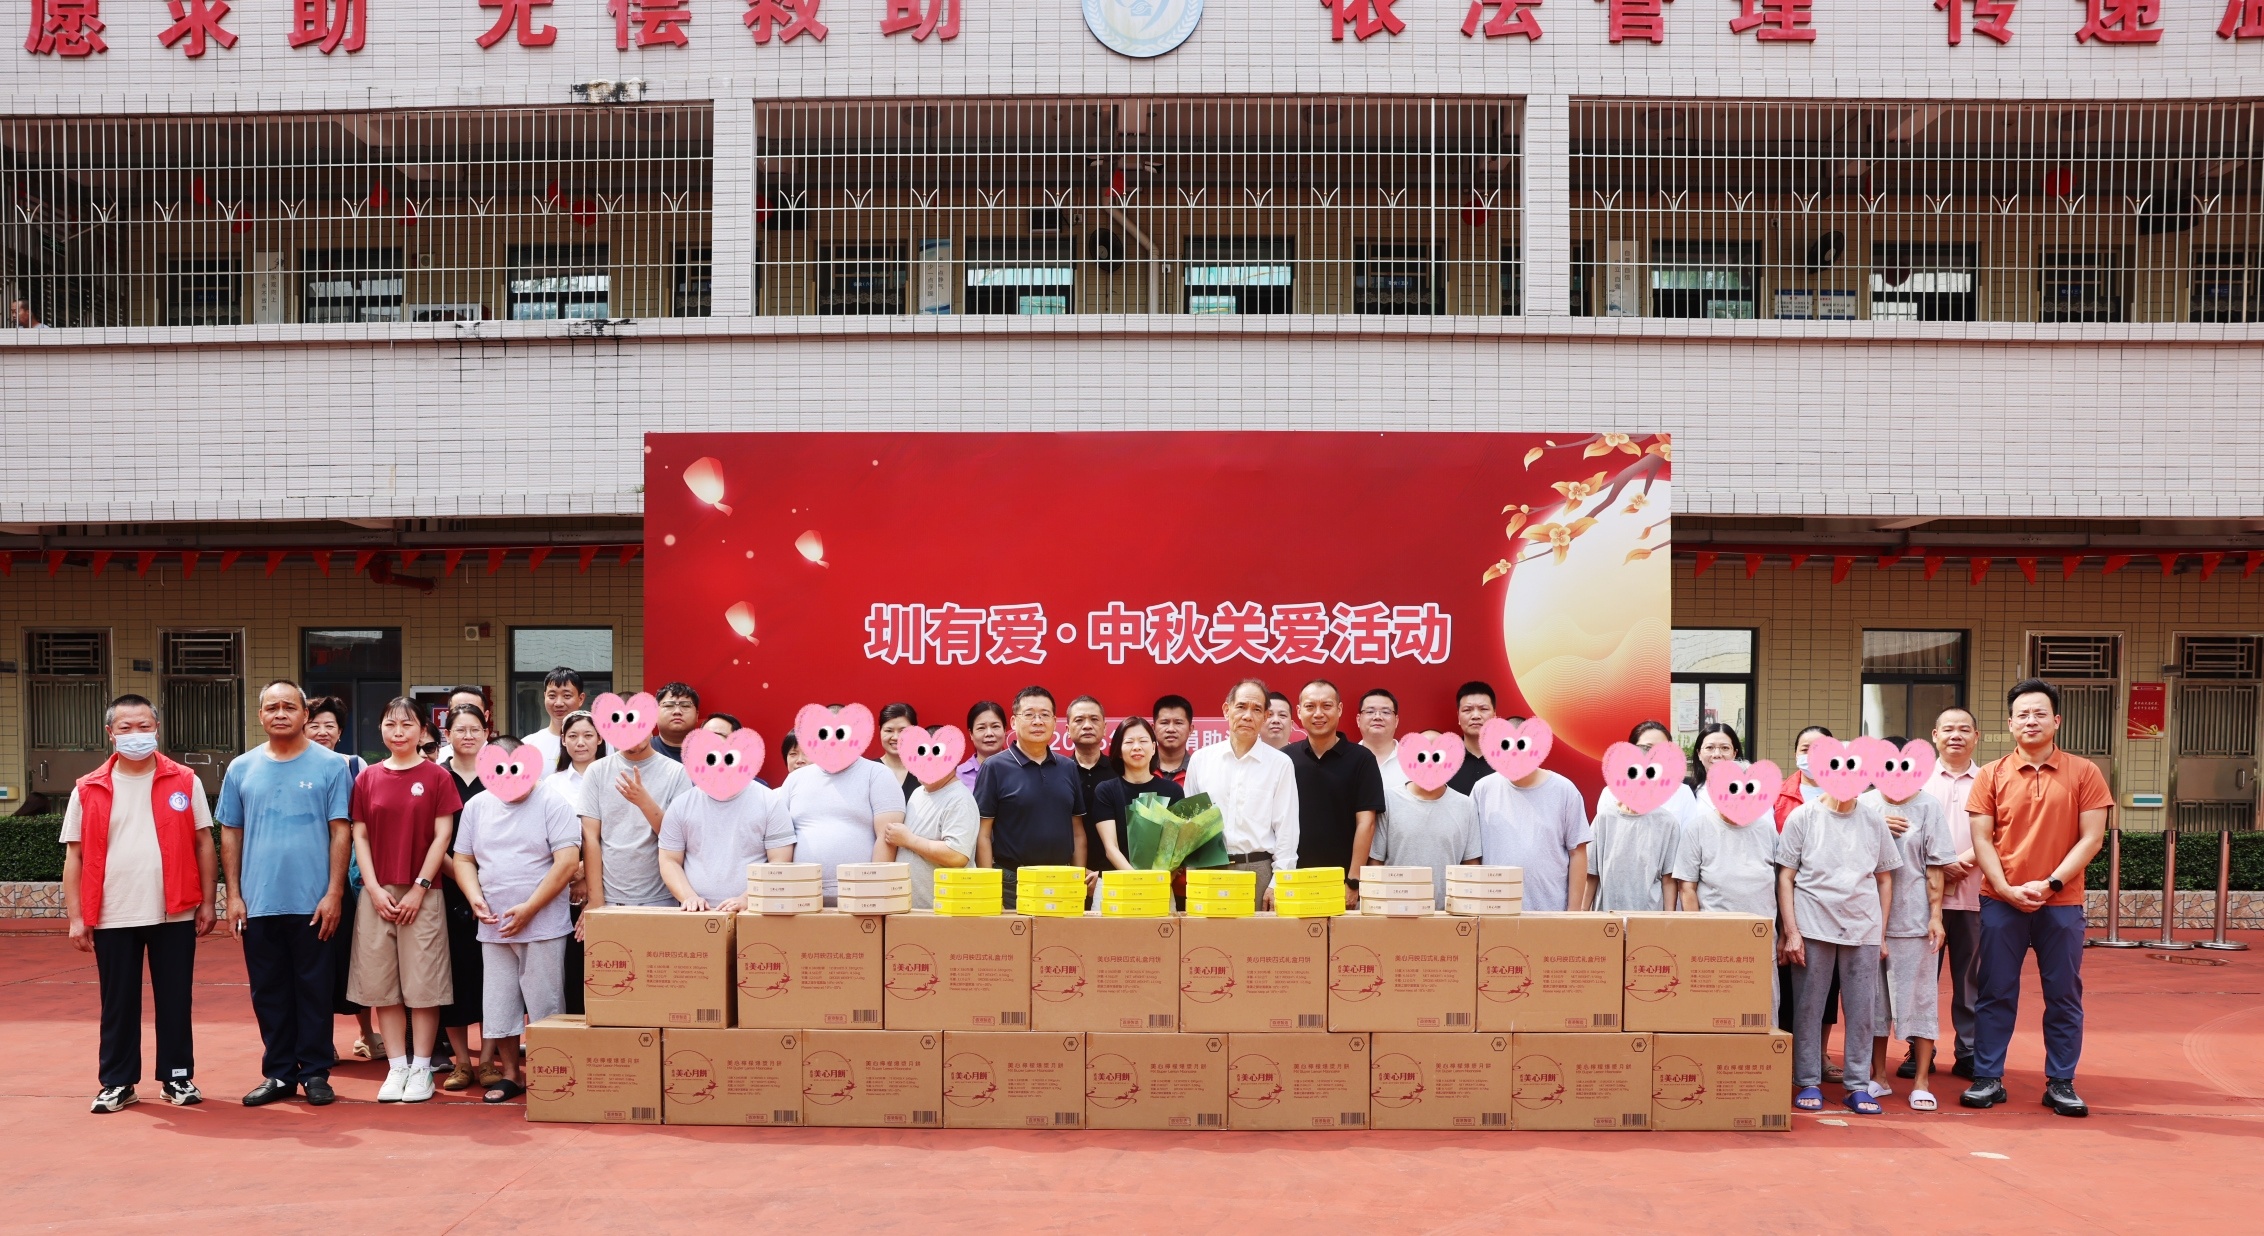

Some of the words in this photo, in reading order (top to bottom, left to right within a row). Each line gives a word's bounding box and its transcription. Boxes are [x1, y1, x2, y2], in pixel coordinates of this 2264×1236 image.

[596, 960, 626, 969] 美心月餅
[750, 962, 781, 971] 美心月餅
[897, 963, 929, 972] 美心月餅
[1342, 964, 1374, 974] 美心月餅
[1044, 965, 1076, 974] 美心月餅
[1193, 966, 1226, 975] 美心月餅
[1491, 966, 1523, 974] 美心月餅
[1638, 965, 1670, 974] 美心月餅
[537, 1066, 567, 1075] 美心月餅
[676, 1069, 708, 1078] 美心月餅
[814, 1070, 846, 1079] 美心月餅
[956, 1072, 988, 1081] 美心月餅
[1098, 1073, 1130, 1082] 美心月餅
[1241, 1073, 1274, 1083] 美心月餅
[1383, 1072, 1416, 1082] 美心月餅
[1524, 1074, 1556, 1083] 美心月餅
[1664, 1074, 1697, 1083] 美心月餅
